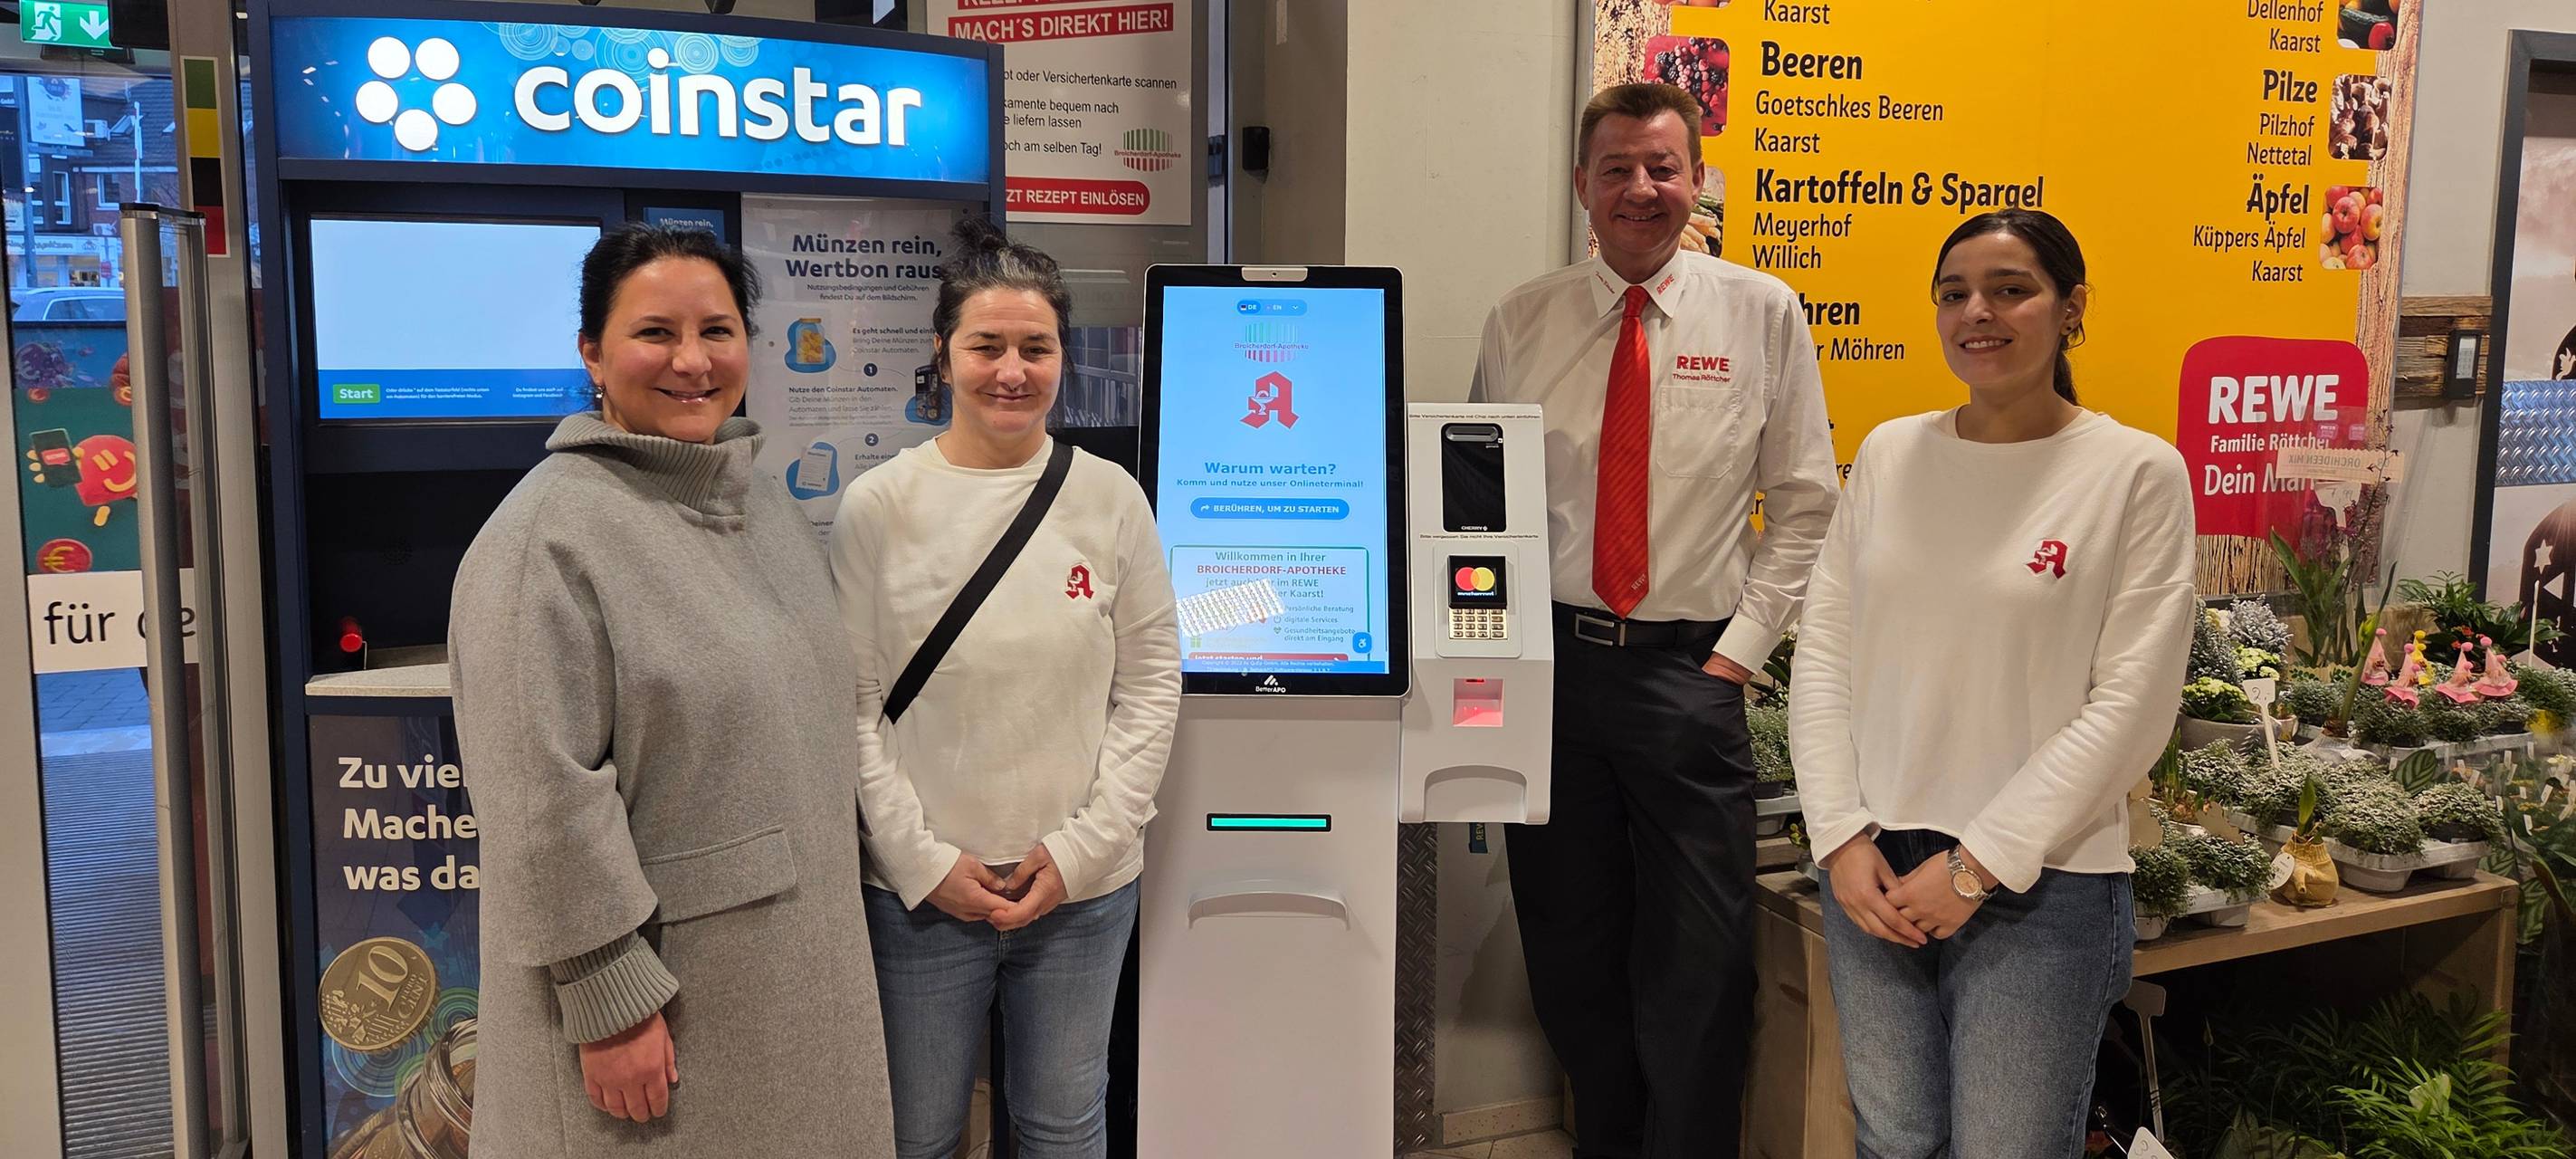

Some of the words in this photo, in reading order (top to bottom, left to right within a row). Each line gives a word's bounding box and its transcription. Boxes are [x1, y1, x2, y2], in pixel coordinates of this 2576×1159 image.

[1040, 13, 1112, 36] DIREKT
[1118, 9, 1168, 32] HIER!
[1764, 0, 1830, 24] Kaarst
[2247, 0, 2323, 23] Dellenhof
[2269, 27, 2321, 53] Kaarst
[1760, 41, 1863, 80] Beeren
[1016, 70, 1040, 81] oder
[1043, 71, 1131, 88] Versichertenkarte
[1134, 77, 1177, 90] scannen
[2263, 69, 2318, 102] Pilze
[514, 47, 921, 146] coinstar
[1049, 100, 1091, 114] bequem
[1093, 102, 1119, 113] nach
[1756, 91, 1871, 120] Goetschkes
[1878, 95, 1944, 121] Beeren
[1013, 114, 1045, 126] liefern
[1048, 115, 1082, 128] lassen
[2259, 112, 2314, 137] Pilzhof
[1004, 140, 1020, 151] och
[1024, 143, 1040, 152] am
[1043, 141, 1077, 153] selben
[1080, 142, 1102, 157] Tag!
[1754, 128, 1820, 154] Kaarst
[2247, 142, 2311, 166] Nettetal
[1026, 189, 1077, 205] REZEPT
[1081, 189, 1144, 206] EINLÖSEN
[1755, 168, 1903, 206] Kartoffeln
[1911, 172, 1933, 206] &
[1941, 173, 2044, 214] Spargel
[2247, 173, 2310, 221] Äpfel
[1753, 212, 1853, 243] Meyerhof
[2193, 225, 2259, 253] Küppers
[2264, 221, 2305, 253] Äpfel
[792, 234, 884, 254] Münzen
[892, 235, 941, 257] rein,
[1752, 244, 1821, 269] Willich
[786, 258, 889, 278] Wertbon
[895, 264, 941, 279] raus
[2252, 260, 2303, 282] Kaarst
[807, 284, 883, 292] Nutzungsbedingungen
[1798, 292, 1860, 326] hren
[1830, 337, 1904, 360] Möhren
[1676, 356, 1730, 372] REWE
[1673, 373, 1700, 381] Thomas
[1701, 374, 1731, 383] Röttcher
[339, 388, 374, 398] Start
[2208, 374, 2340, 425] REWE
[2210, 434, 2265, 453] Familie
[1205, 462, 1264, 474] Warum
[1270, 463, 1336, 475] warten?
[2204, 464, 2255, 495] Dein
[1290, 479, 1363, 488] Onlineterminal!
[1213, 503, 1264, 514] BERÜHREN,
[1267, 504, 1281, 513] UM
[1283, 504, 1295, 513] ZU
[1298, 504, 1339, 514] STARTEN
[1215, 551, 1283, 561] Willkommen
[1287, 551, 1297, 561] in
[1300, 551, 1326, 562] Ihrer
[1197, 564, 1346, 575] BROICHERDORF-APOTHEKE
[1277, 579, 1289, 587] im
[1292, 580, 1319, 588] REWE
[1290, 589, 1323, 599] Kaarst!
[43, 601, 115, 645] für
[1284, 627, 1356, 636] Gesundheitsangebote
[339, 757, 387, 789] Zu
[396, 753, 467, 789] vie
[343, 804, 478, 840] Mache
[343, 866, 421, 891] was
[356, 945, 408, 1012] 10
